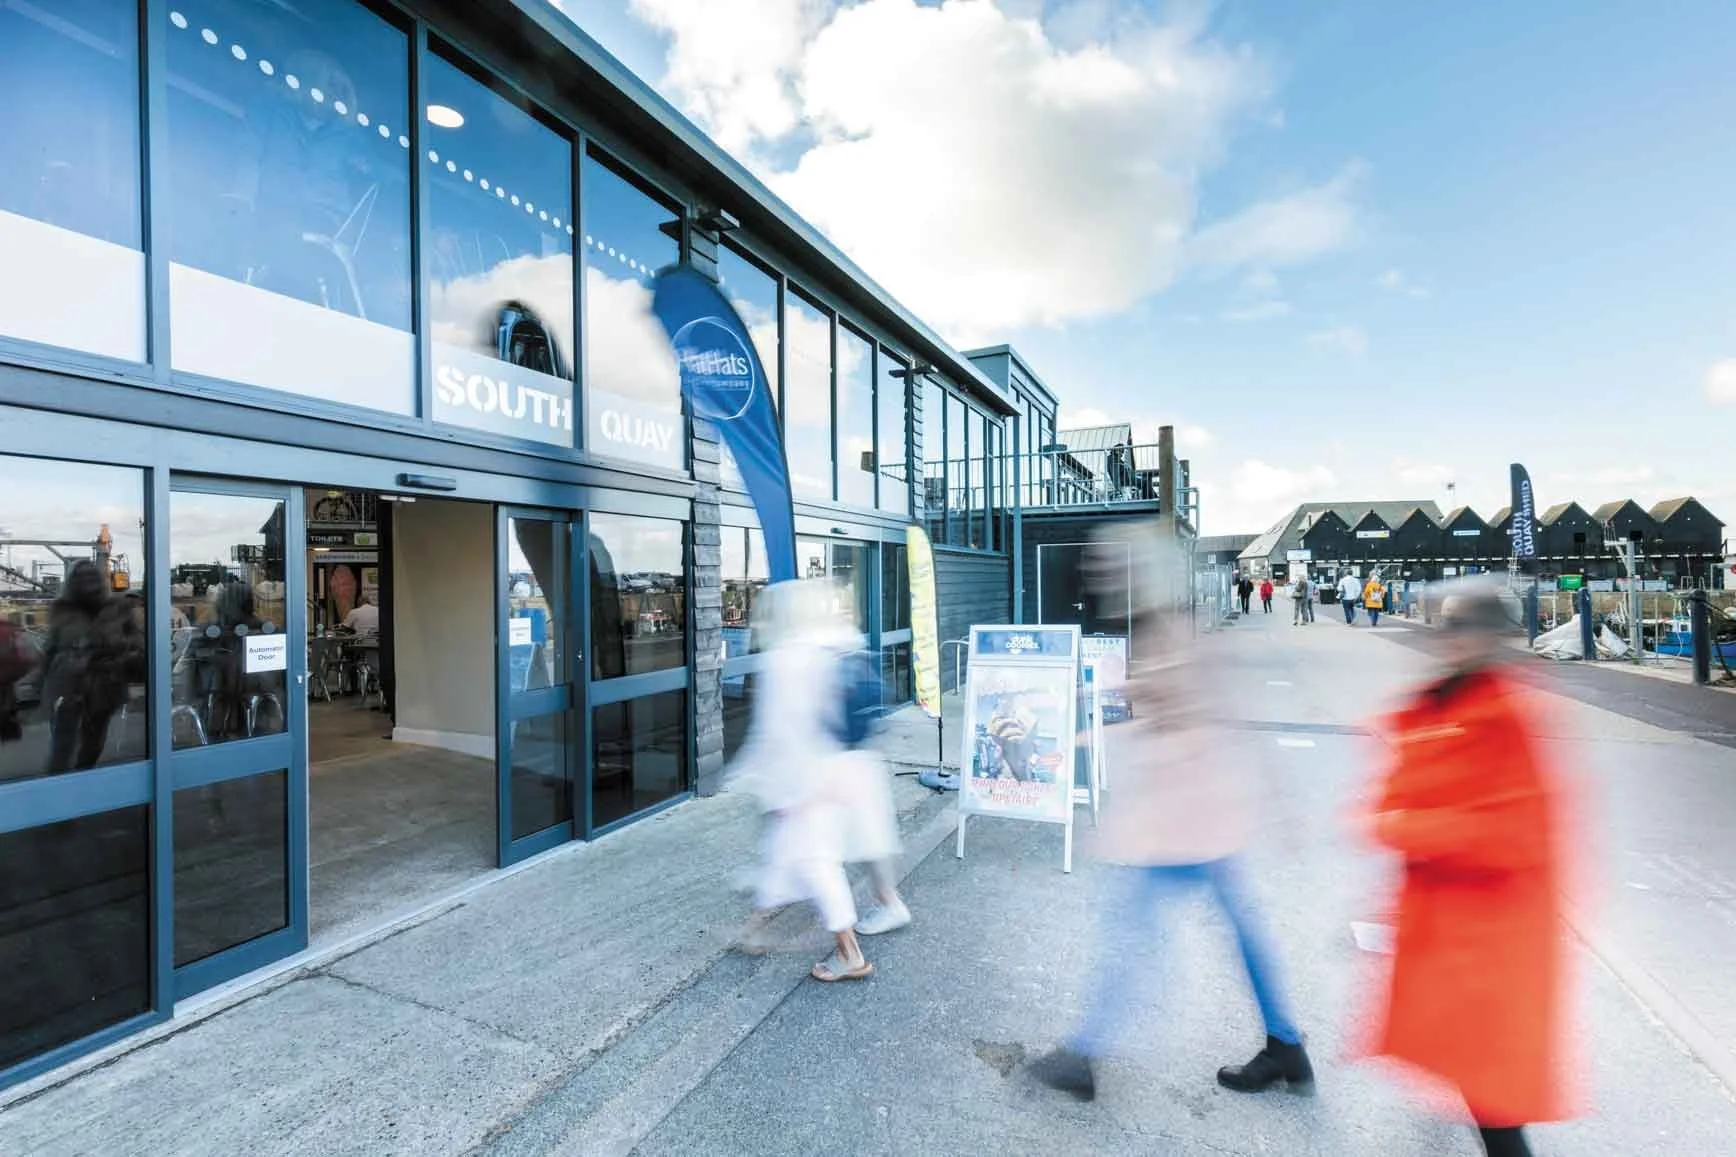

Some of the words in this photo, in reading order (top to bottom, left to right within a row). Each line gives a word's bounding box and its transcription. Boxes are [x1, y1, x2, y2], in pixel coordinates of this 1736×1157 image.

[437, 365, 572, 430] SOUTH
[601, 409, 673, 452] QUAY
[1523, 519, 1535, 556] QUAY
